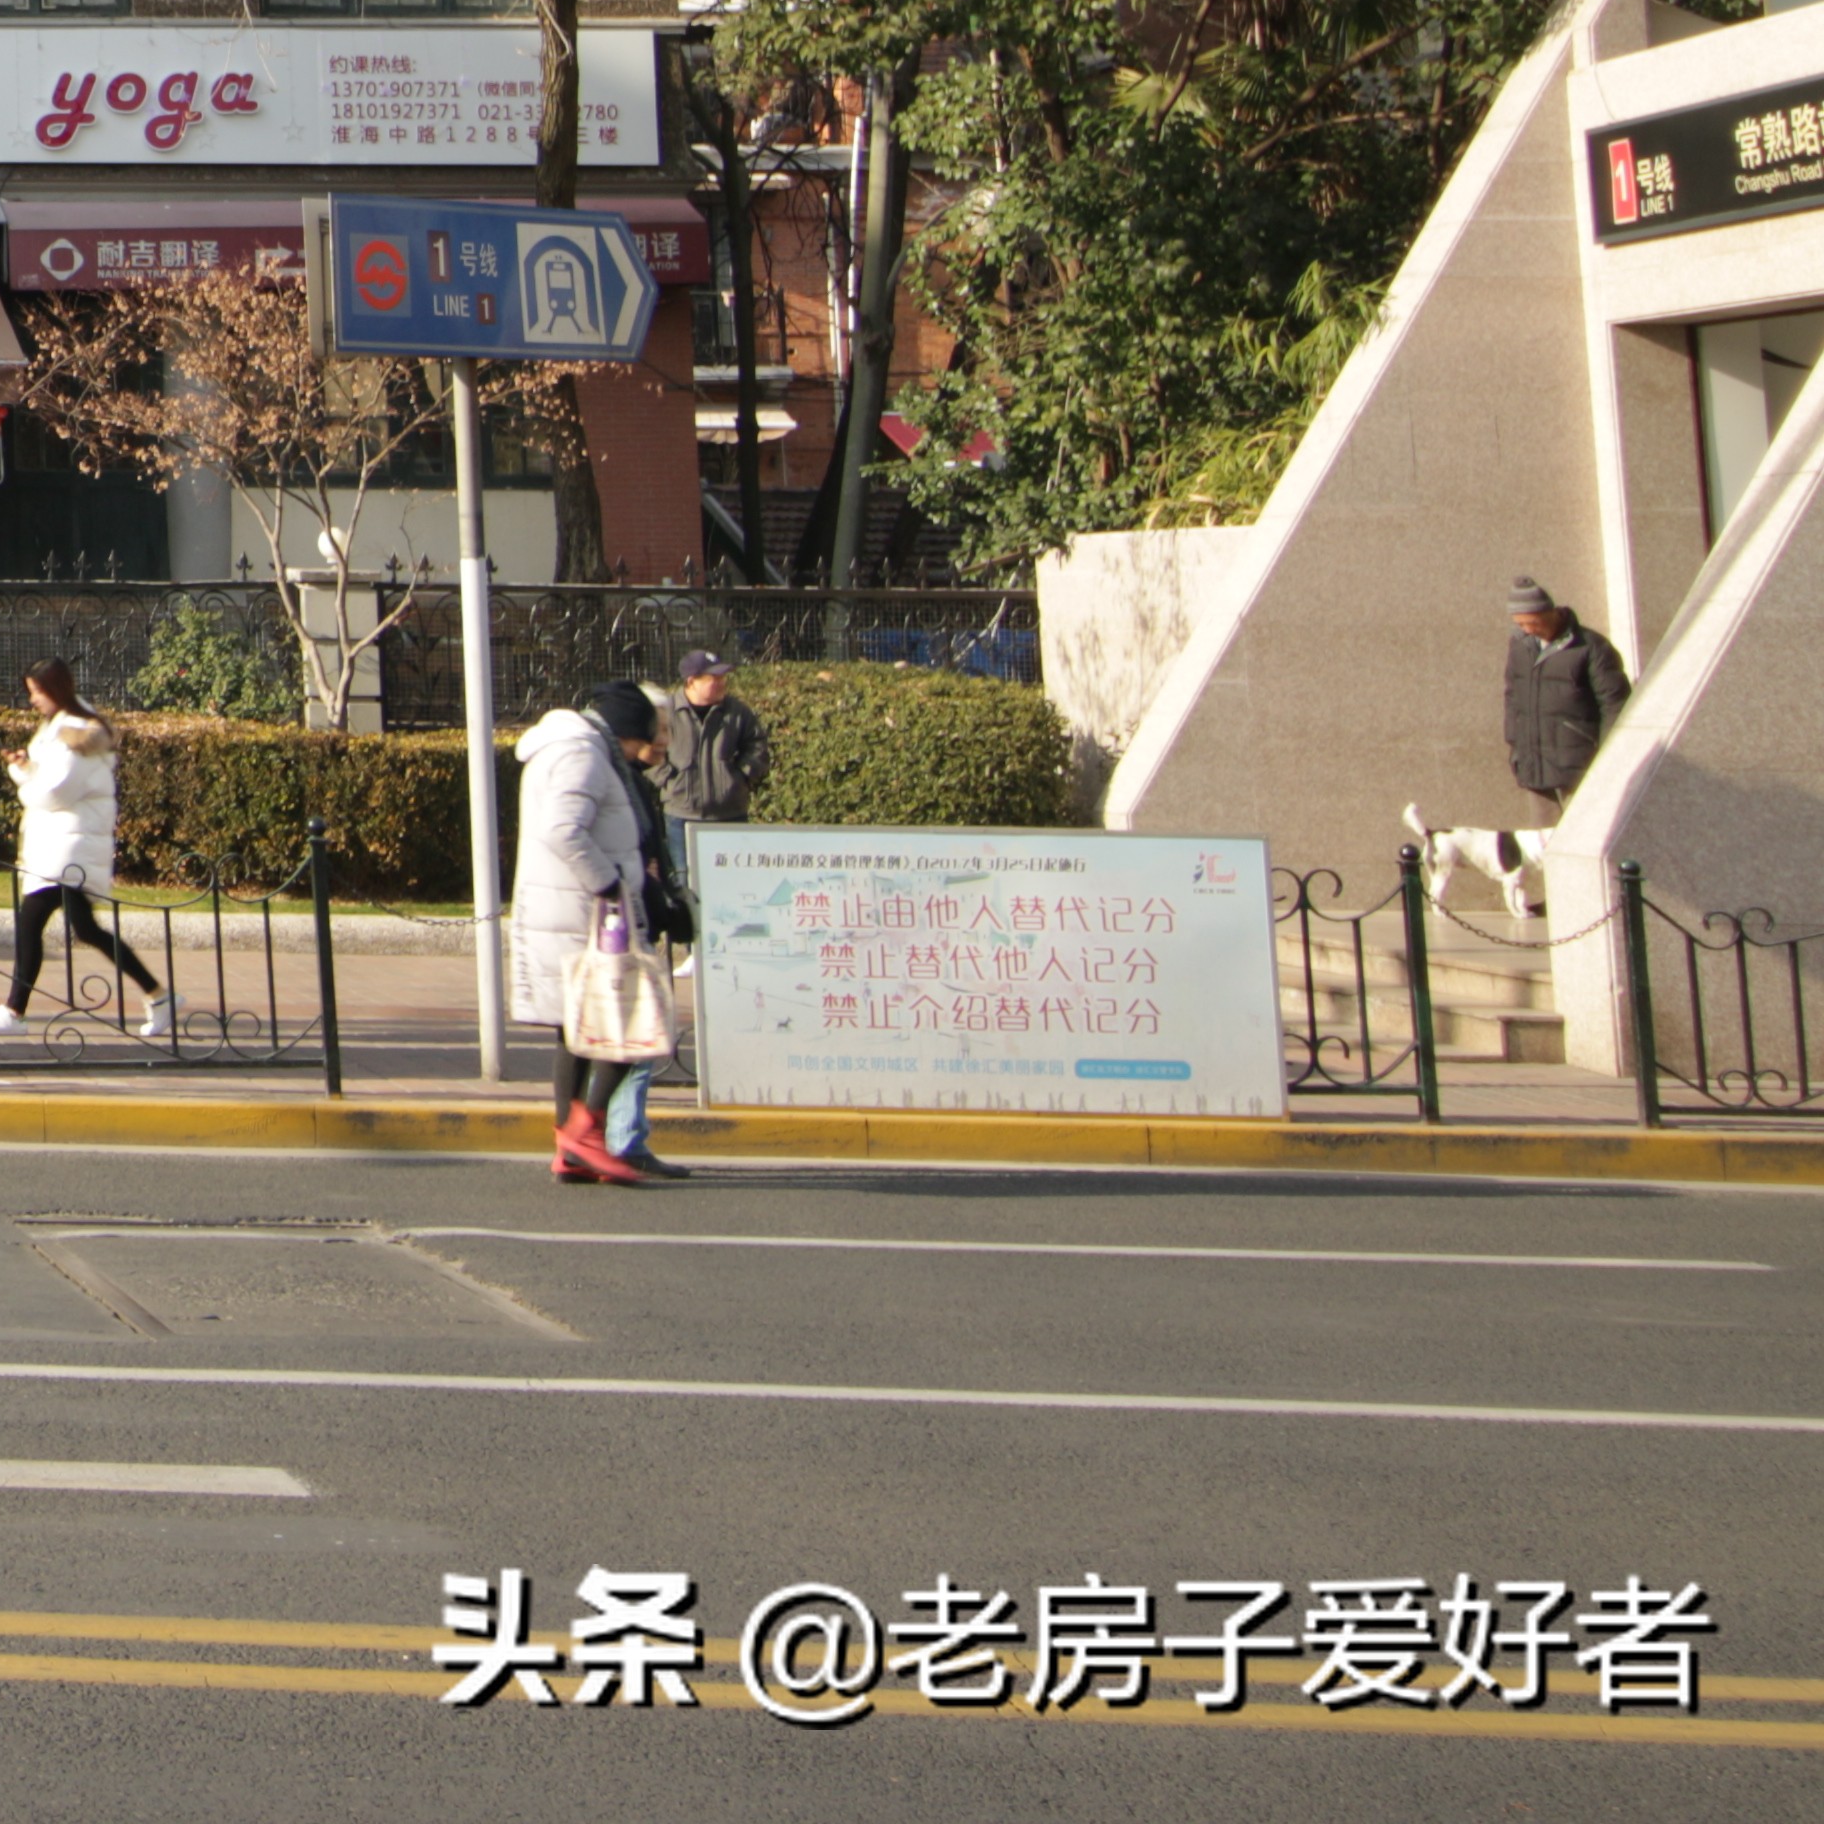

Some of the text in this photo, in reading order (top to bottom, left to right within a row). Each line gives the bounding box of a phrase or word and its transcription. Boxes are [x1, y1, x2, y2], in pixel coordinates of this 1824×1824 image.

[329, 55, 417, 75] 约课热线:
[331, 81, 460, 98] 13701907371
[34, 70, 258, 150] yoga
[331, 103, 461, 120] 18101927371
[1735, 100, 1824, 170] 常熟路
[1735, 159, 1824, 194] Changshu Road
[1641, 193, 1674, 217] LINE 1
[97, 239, 220, 268] 耐吉翻译
[433, 294, 490, 320] LINE 1
[794, 891, 1177, 934] 禁止由他人替代记分
[819, 942, 1159, 984] 禁止替代他人记分
[822, 992, 1162, 1035] 禁止介绍替代记分
[786, 1054, 920, 1073] 同创全国文明城区
